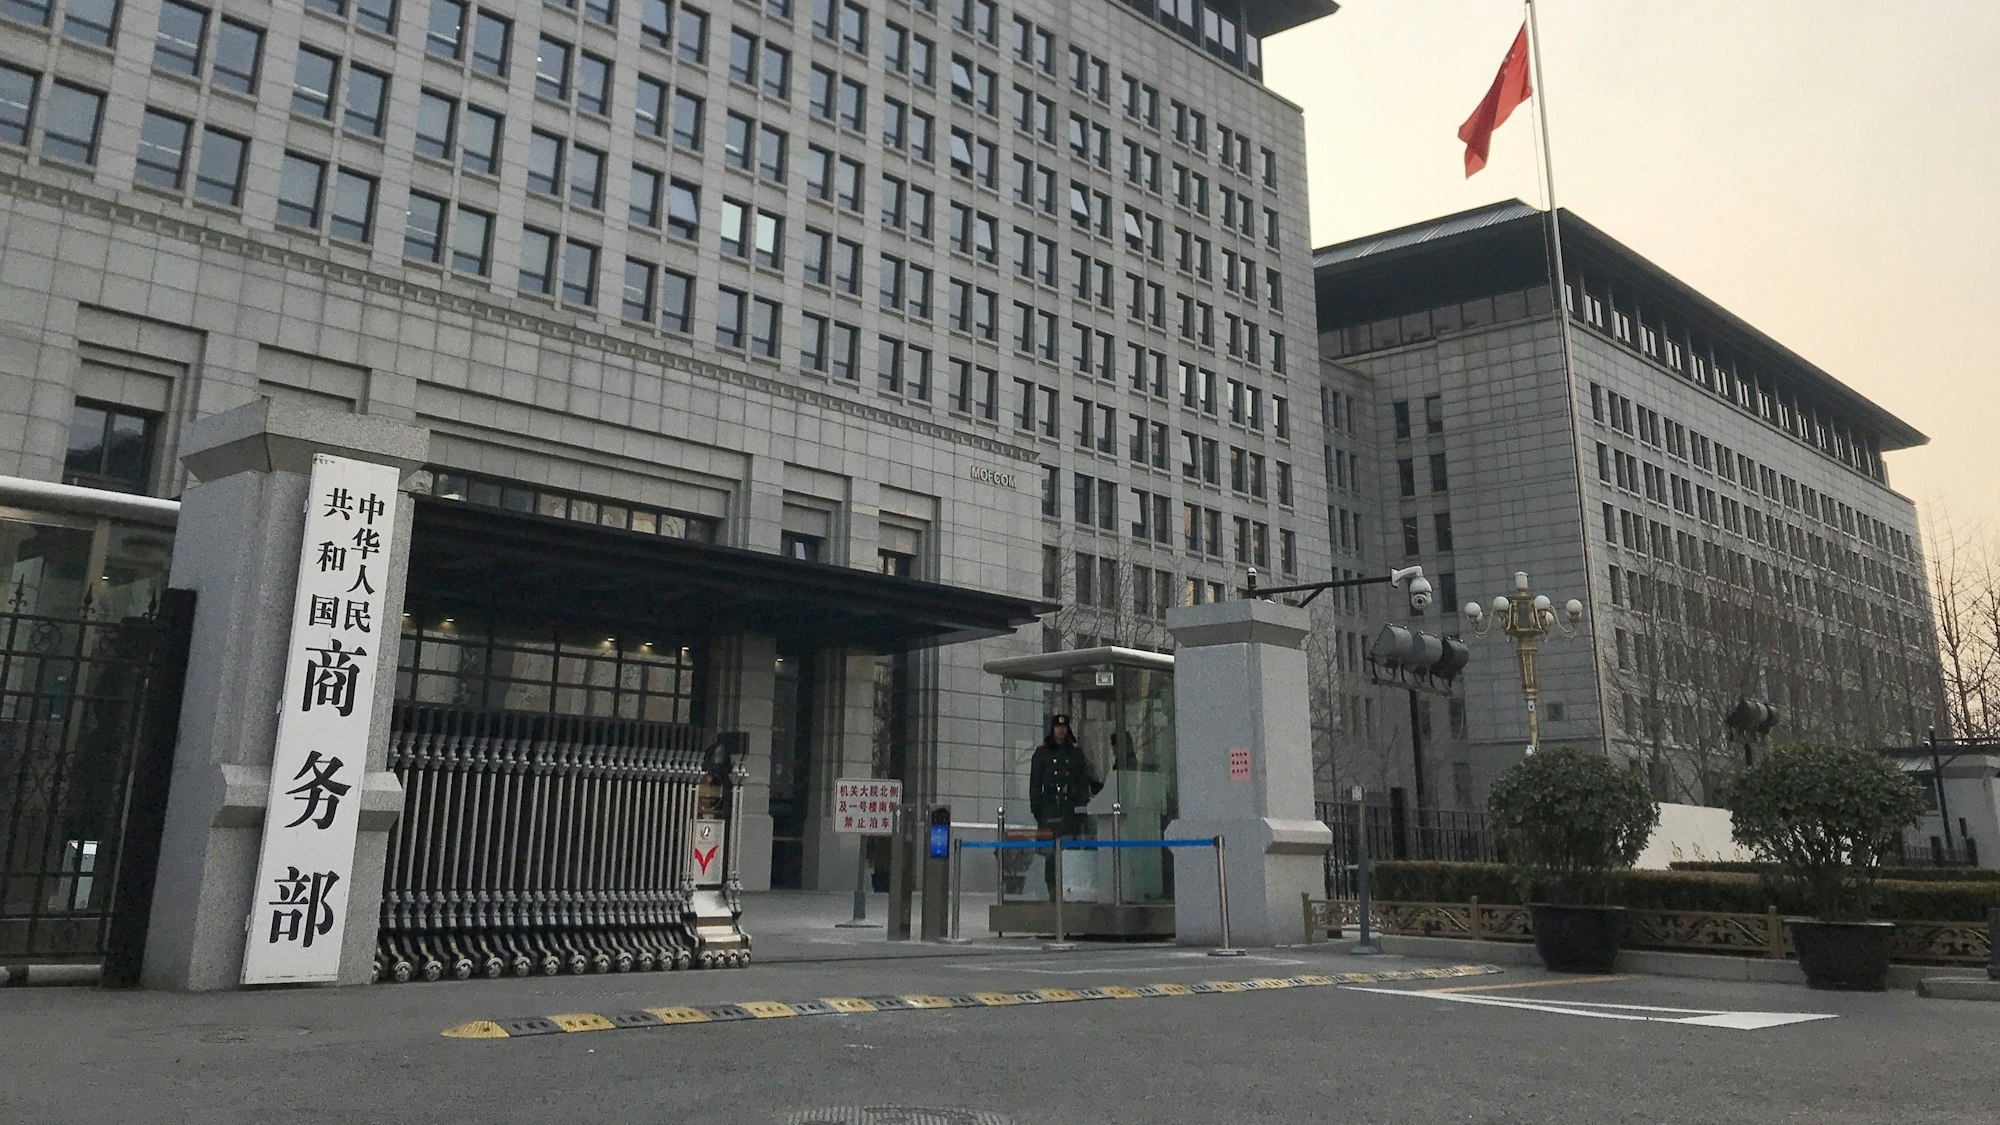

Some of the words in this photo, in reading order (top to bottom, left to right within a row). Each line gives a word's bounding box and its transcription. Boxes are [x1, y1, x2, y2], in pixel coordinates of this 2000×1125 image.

[970, 465, 1017, 488] MOFCOM
[308, 486, 355, 630] 共和国
[344, 492, 386, 634] 中华人民
[268, 638, 369, 949] 商务部
[840, 785, 899, 798] 机关大院北侧
[844, 816, 890, 829] 禁止泊车
